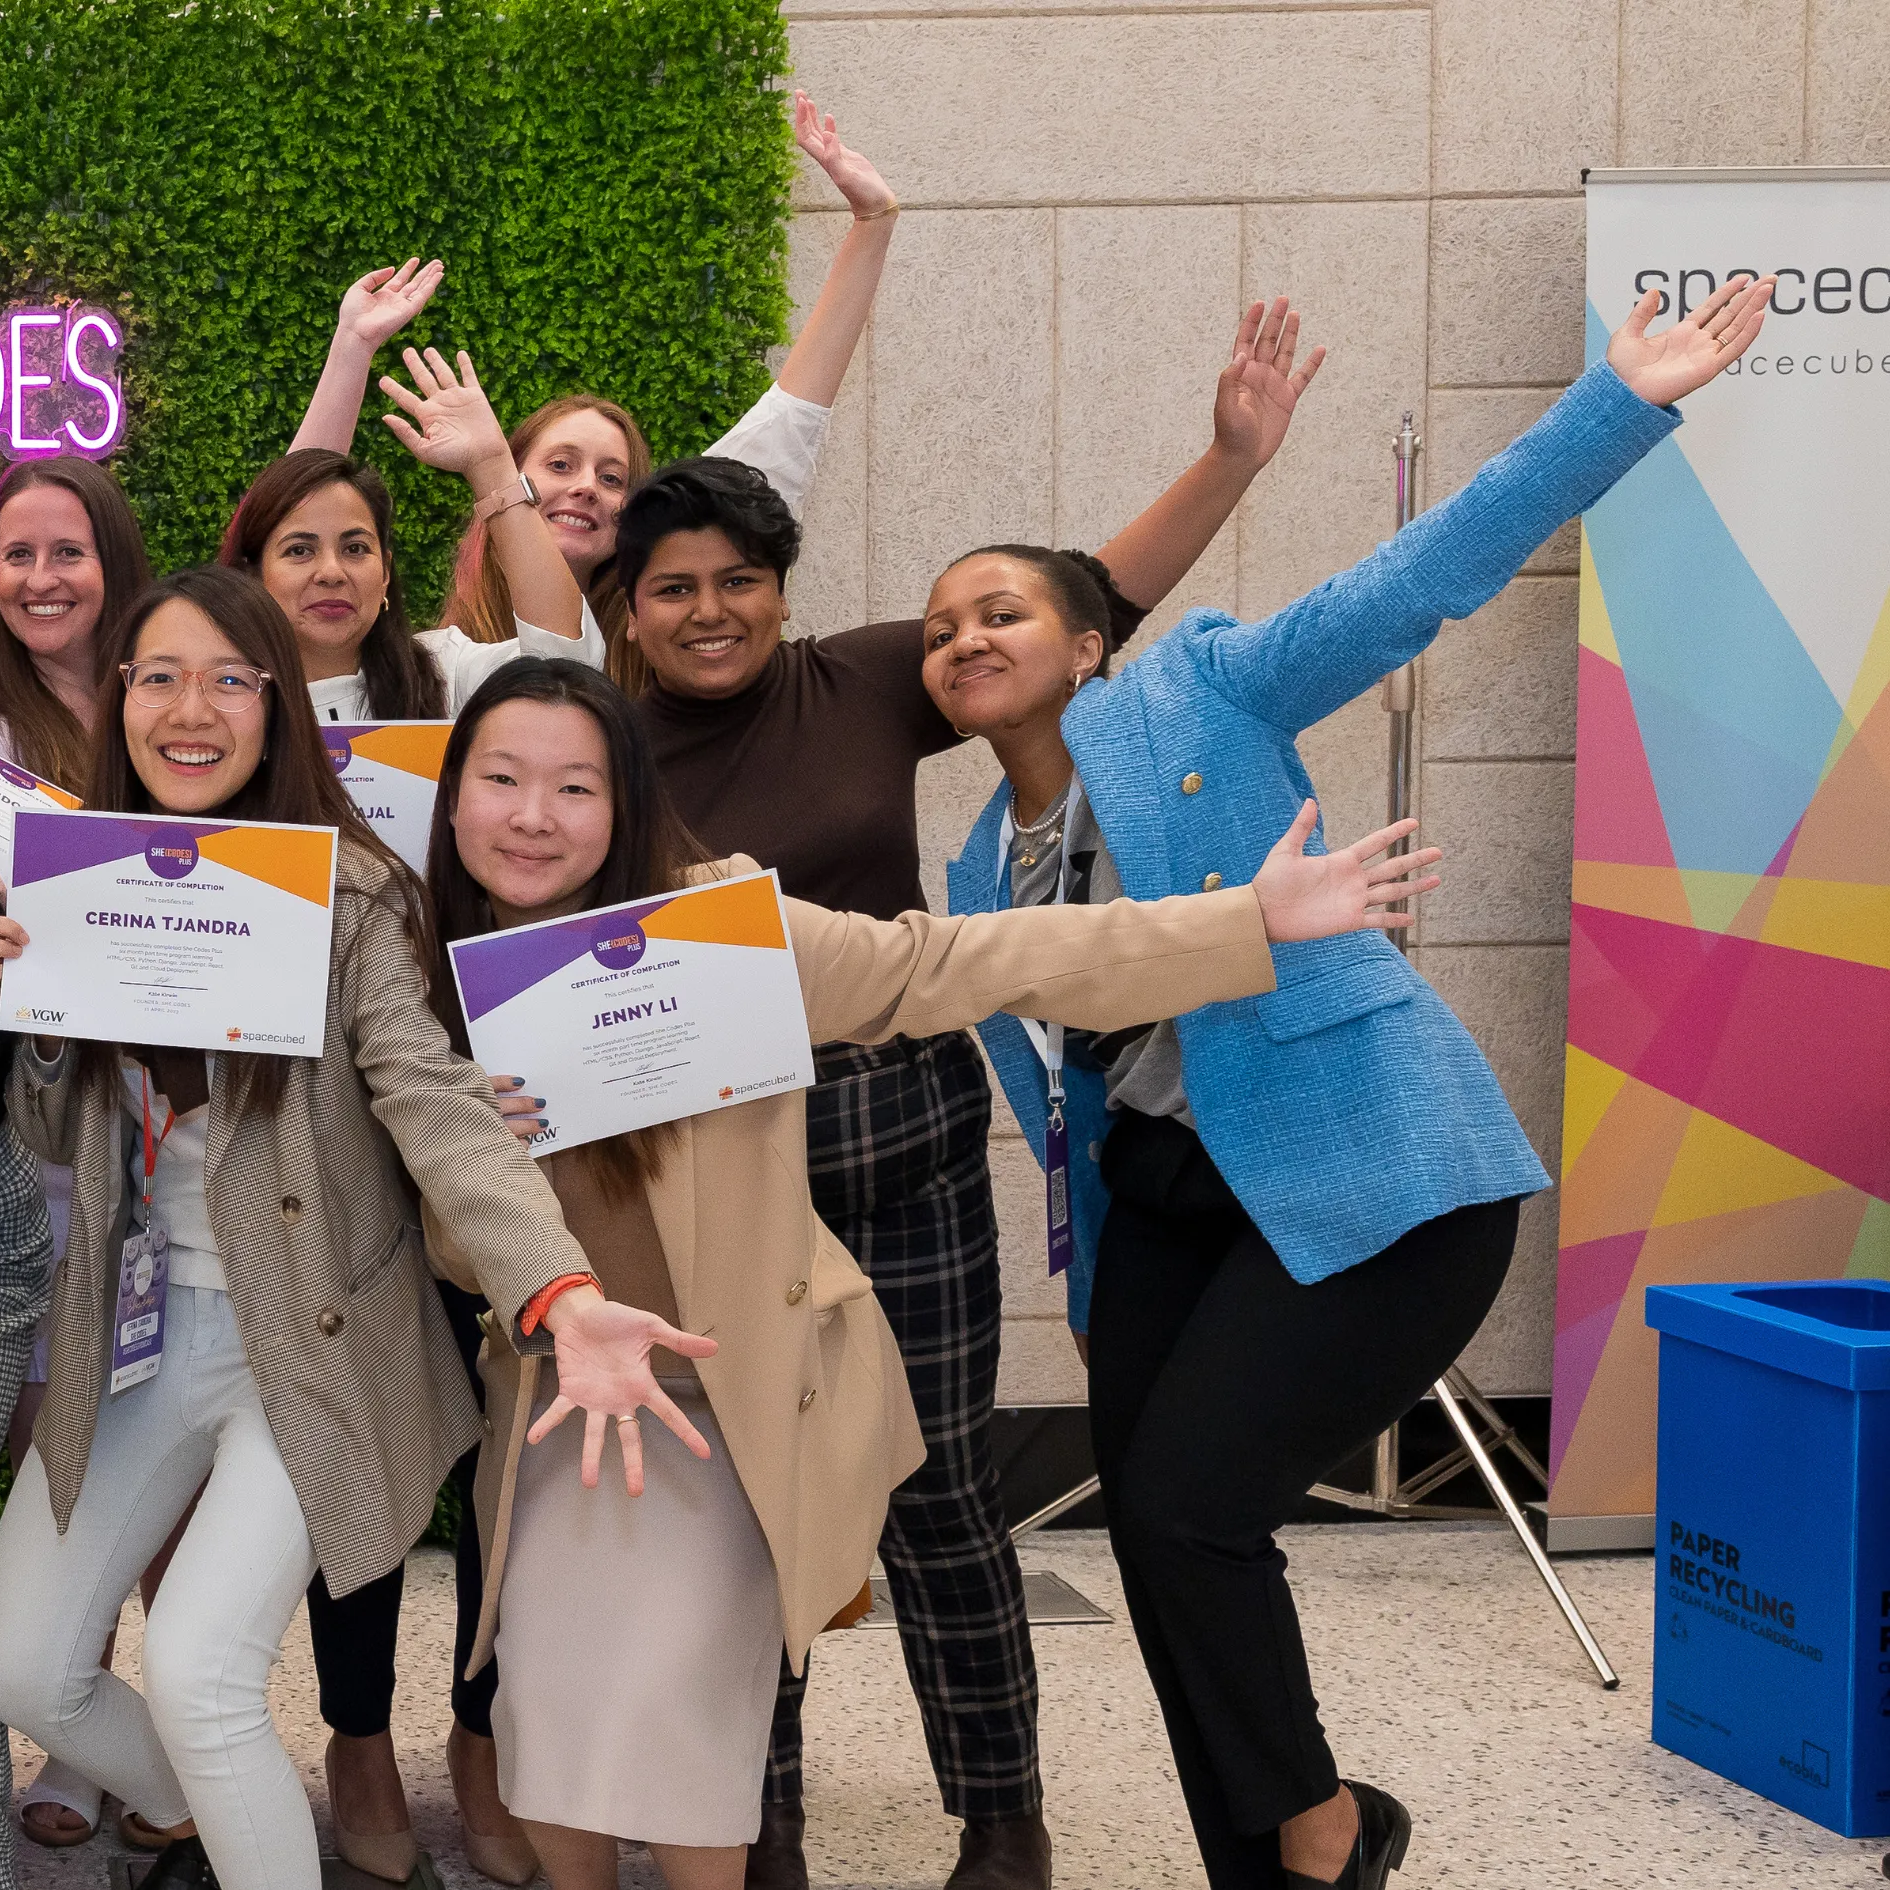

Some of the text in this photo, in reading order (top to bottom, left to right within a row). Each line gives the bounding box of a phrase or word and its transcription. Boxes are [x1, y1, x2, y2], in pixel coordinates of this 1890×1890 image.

[116, 878, 163, 886] CERTIFICATE
[176, 882, 224, 890] COMPLETION
[85, 911, 251, 936] CERINA TJANDRA
[570, 958, 680, 990] CERTIFICATE OF COMPLETION
[31, 1009, 64, 1022] VGW
[590, 996, 677, 1030] JENNY LI
[242, 1030, 305, 1046] spacecubed
[733, 1071, 796, 1095] spacecubed
[1671, 1520, 1740, 1572] PAPER
[1670, 1554, 1794, 1628] RECYCLING
[1669, 1586, 1701, 1608] CLEAN
[1704, 1602, 1738, 1626] PAPER
[1750, 1620, 1822, 1660] CARDBOARD
